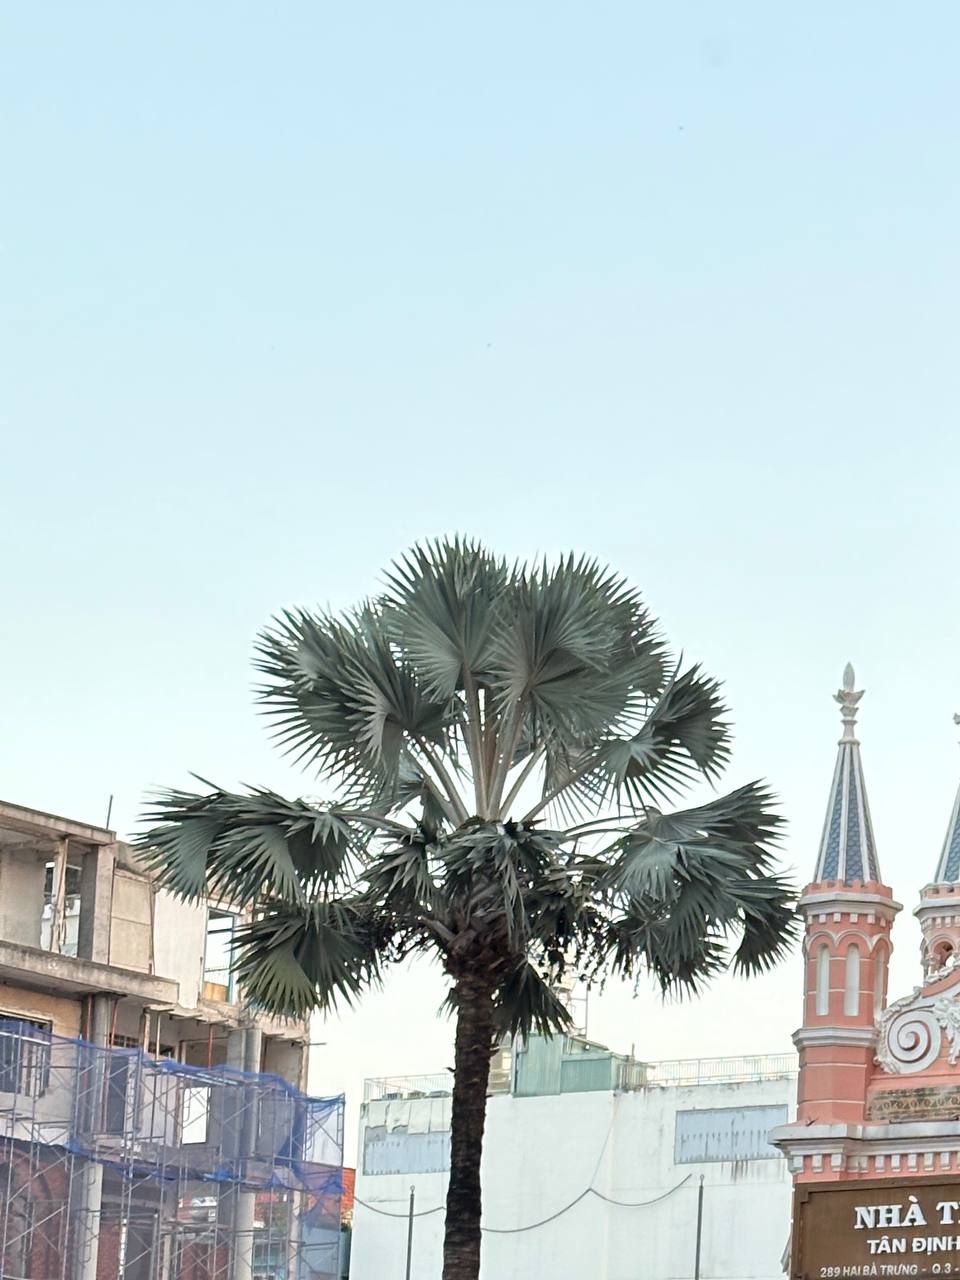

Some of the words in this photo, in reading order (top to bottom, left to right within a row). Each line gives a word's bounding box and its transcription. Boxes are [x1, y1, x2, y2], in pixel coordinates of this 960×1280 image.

[854, 1195, 927, 1229] NHÀ
[867, 1235, 906, 1254] TÂN
[820, 1266, 841, 1278] 289
[843, 1265, 861, 1277] HAI
[862, 1261, 878, 1276] BÀ
[880, 1263, 918, 1276] TRƯNG
